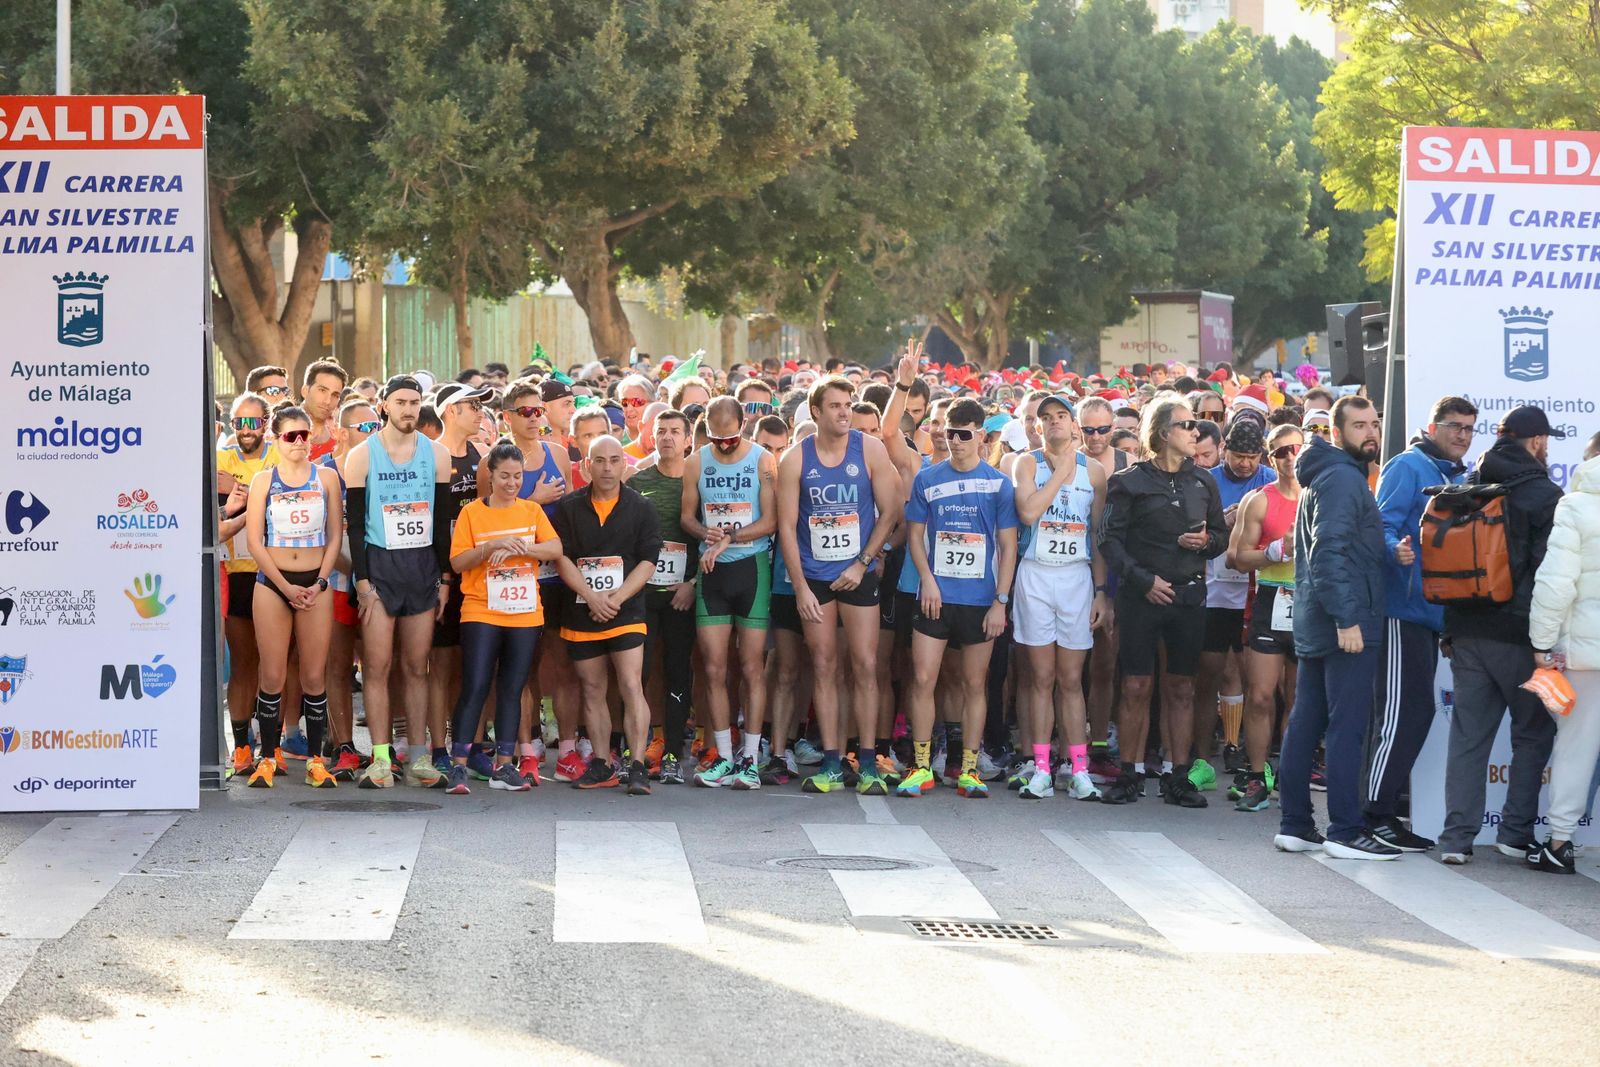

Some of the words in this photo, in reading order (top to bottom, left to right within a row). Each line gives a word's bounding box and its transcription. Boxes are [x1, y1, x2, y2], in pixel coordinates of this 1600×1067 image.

[0, 105, 190, 142] ALIDA
[1418, 137, 1600, 176] SALID
[64, 175, 183, 193] CARRERA
[0, 208, 39, 226] AN
[46, 207, 180, 226] SILVESTRE
[1423, 192, 1495, 226] XII
[1509, 209, 1600, 229] CARRER
[3, 236, 58, 254] LMA
[66, 235, 195, 254] PALMILLA
[1432, 240, 1484, 259] SAN
[1491, 242, 1600, 262] SILVESTR
[1415, 268, 1503, 287] PALMA
[1511, 271, 1600, 290] PALMIL
[10, 360, 150, 381] Ayuntamiento
[28, 386, 52, 402] de
[59, 385, 132, 405] Málaga
[16, 452, 25, 461] la
[27, 452, 59, 461] ciudad
[60, 452, 99, 461] redonda
[378, 469, 418, 483] nerja
[705, 473, 752, 491] nerja
[809, 483, 859, 505] RCM
[290, 509, 310, 525] 65
[945, 504, 978, 513] ortodent
[1046, 504, 1083, 522] Málaga
[97, 514, 179, 530] ROSALEDA
[397, 521, 424, 536] 565
[0, 537, 59, 552] rrefour
[110, 540, 132, 550] desde
[134, 543, 163, 551] siempre
[821, 534, 851, 549] 215
[1048, 540, 1078, 555] 216
[946, 551, 976, 566] 379
[500, 586, 529, 601] 432
[20, 777, 42, 793] dp
[53, 777, 137, 792] deporinter
